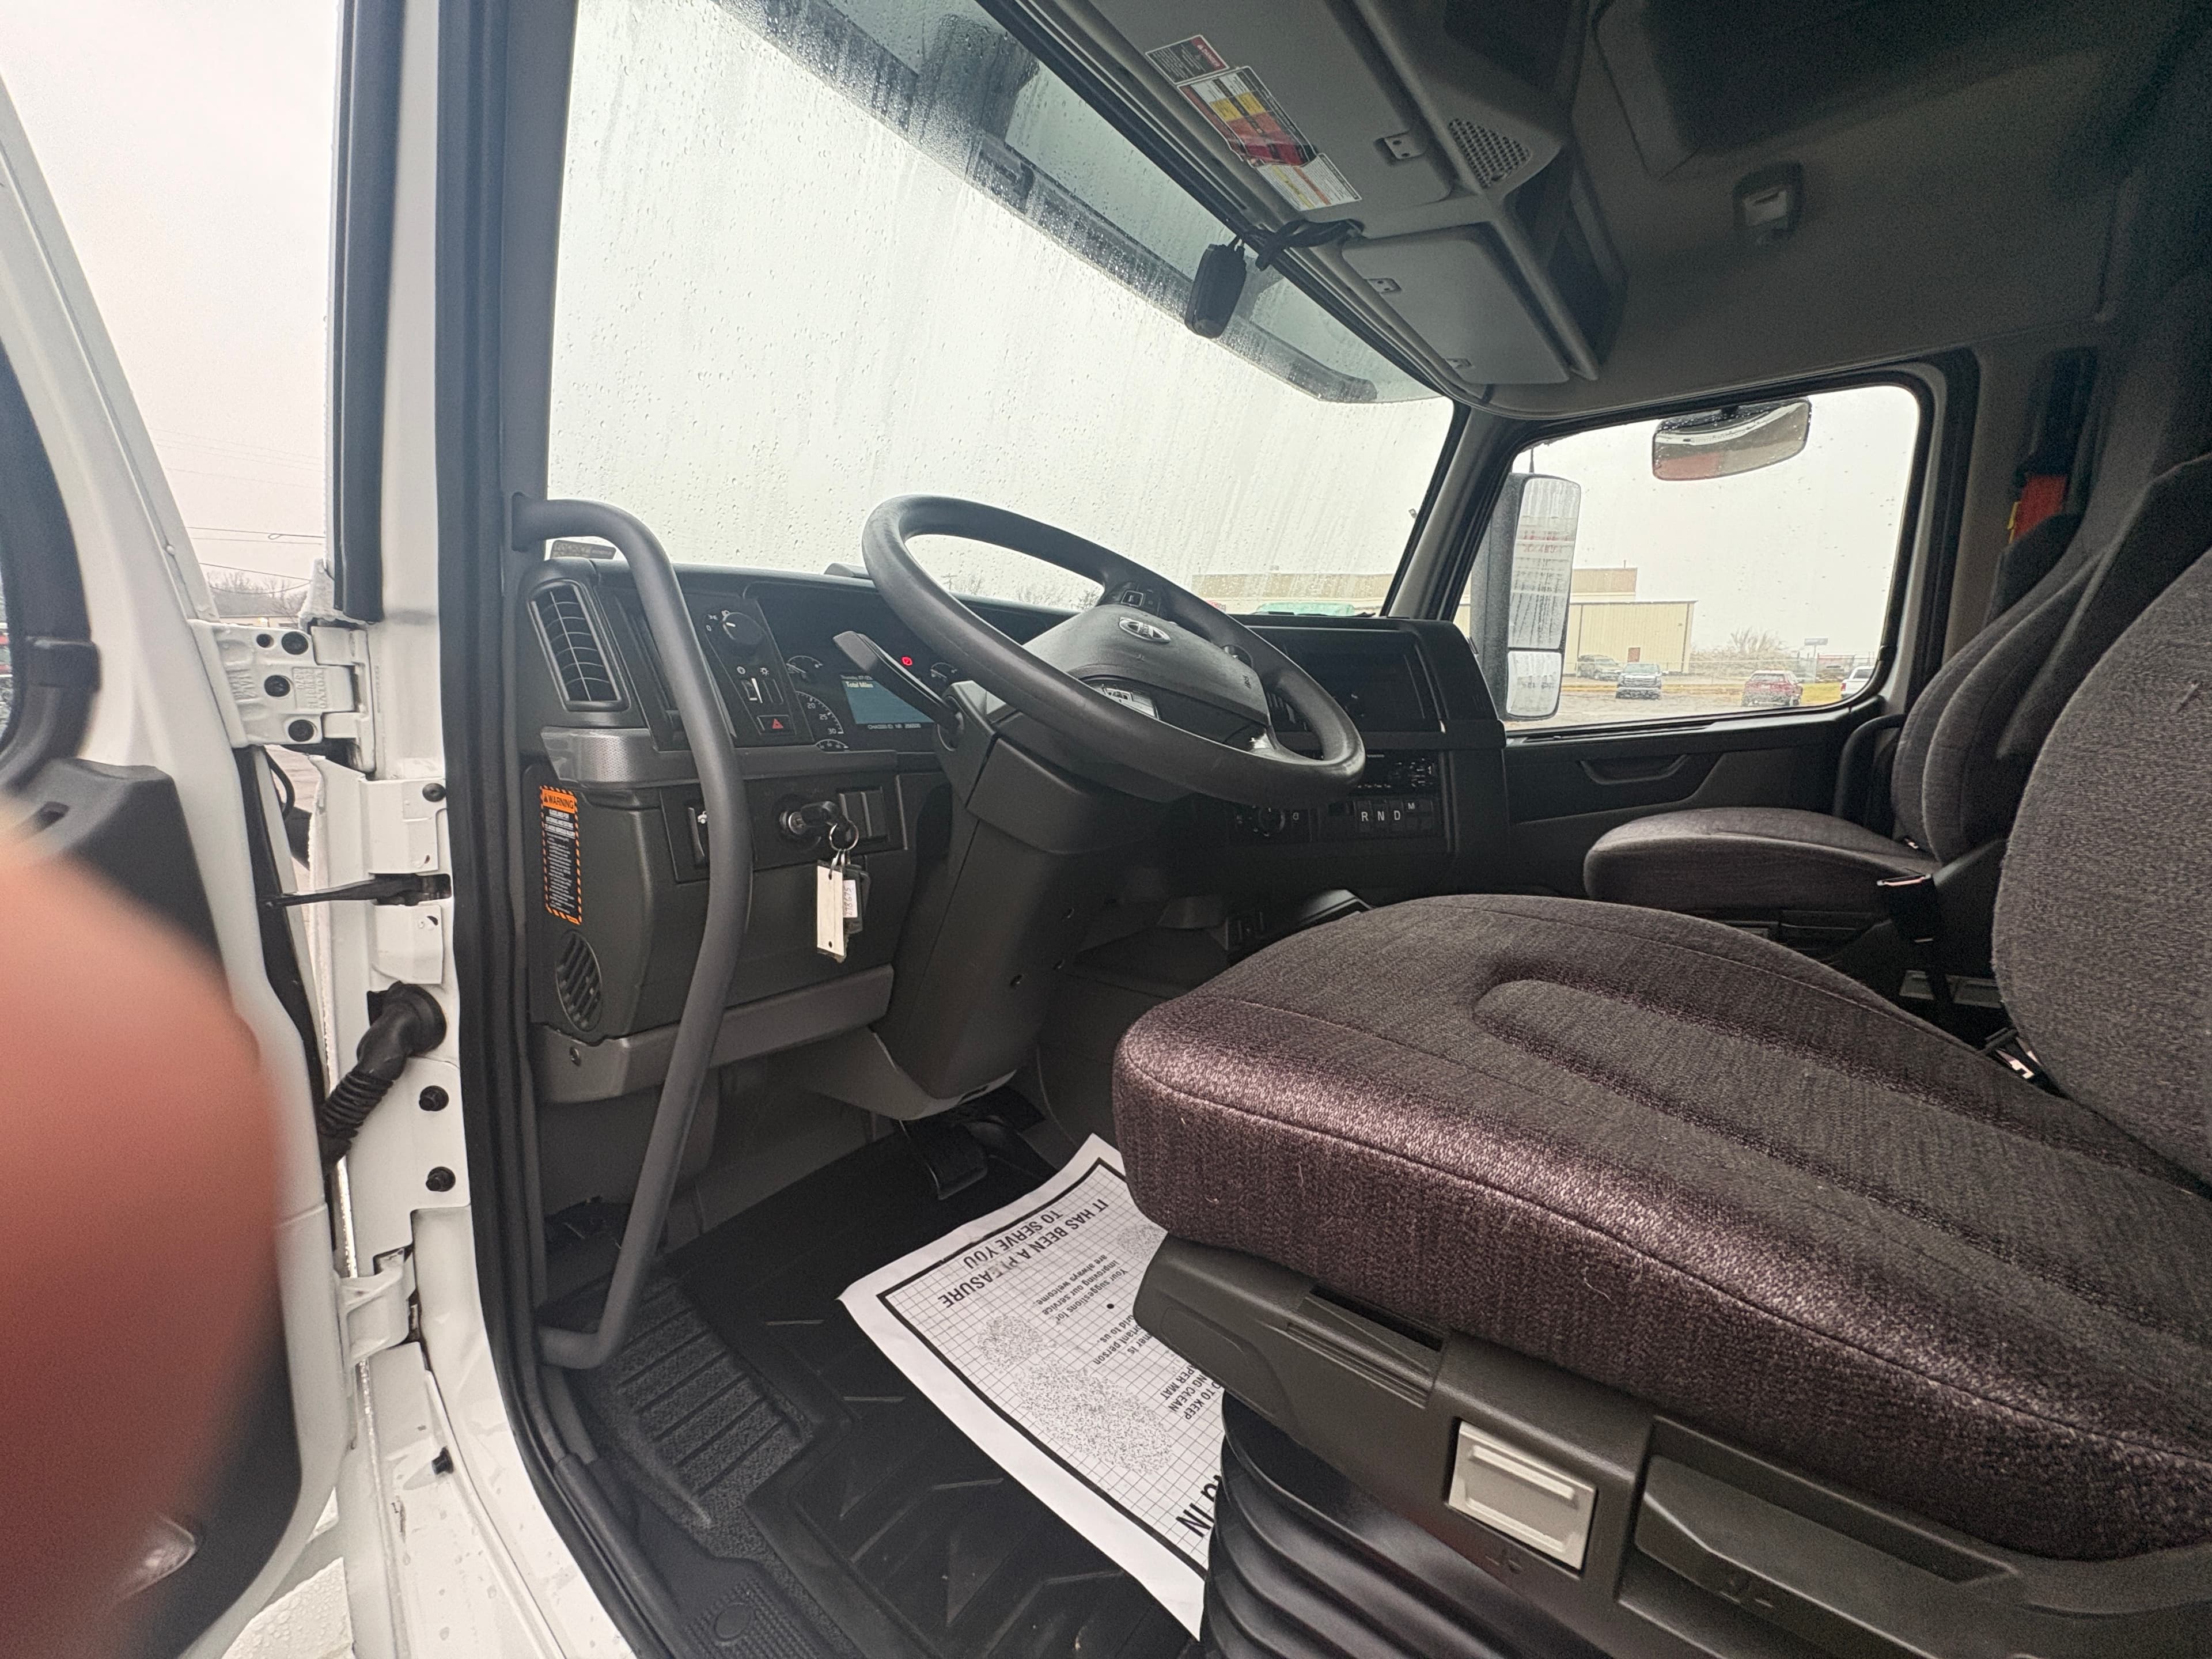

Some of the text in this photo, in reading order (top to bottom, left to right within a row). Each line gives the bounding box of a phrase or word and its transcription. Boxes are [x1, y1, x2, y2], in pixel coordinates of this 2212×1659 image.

[548, 795, 574, 809] WARNING
[1361, 812, 1369, 821] R
[1377, 811, 1385, 821] N
[1394, 810, 1401, 820] D
[1093, 1199, 1109, 1212] IT
[1065, 1209, 1096, 1230] HAS
[963, 1210, 1063, 1269] TO SERVE YOU
[1029, 1226, 1069, 1253] BEEN
[1017, 1248, 1032, 1259] A
[1094, 1254, 1107, 1264] are
[1069, 1263, 1095, 1282] always
[1055, 1268, 1128, 1322] Your suggestions for
[1070, 1285, 1084, 1296] our
[1042, 1293, 1071, 1315] service
[1119, 1315, 1134, 1329] orld
[1111, 1327, 1122, 1335] to
[1093, 1341, 1121, 1365] person
[1127, 1346, 1139, 1354] is
[1160, 1382, 1180, 1400] MAT
[1200, 1389, 1215, 1400] TO
[1168, 1387, 1196, 1412] CLEAN
[1184, 1399, 1205, 1420] KEEP
[1176, 1503, 1214, 1537] IN
